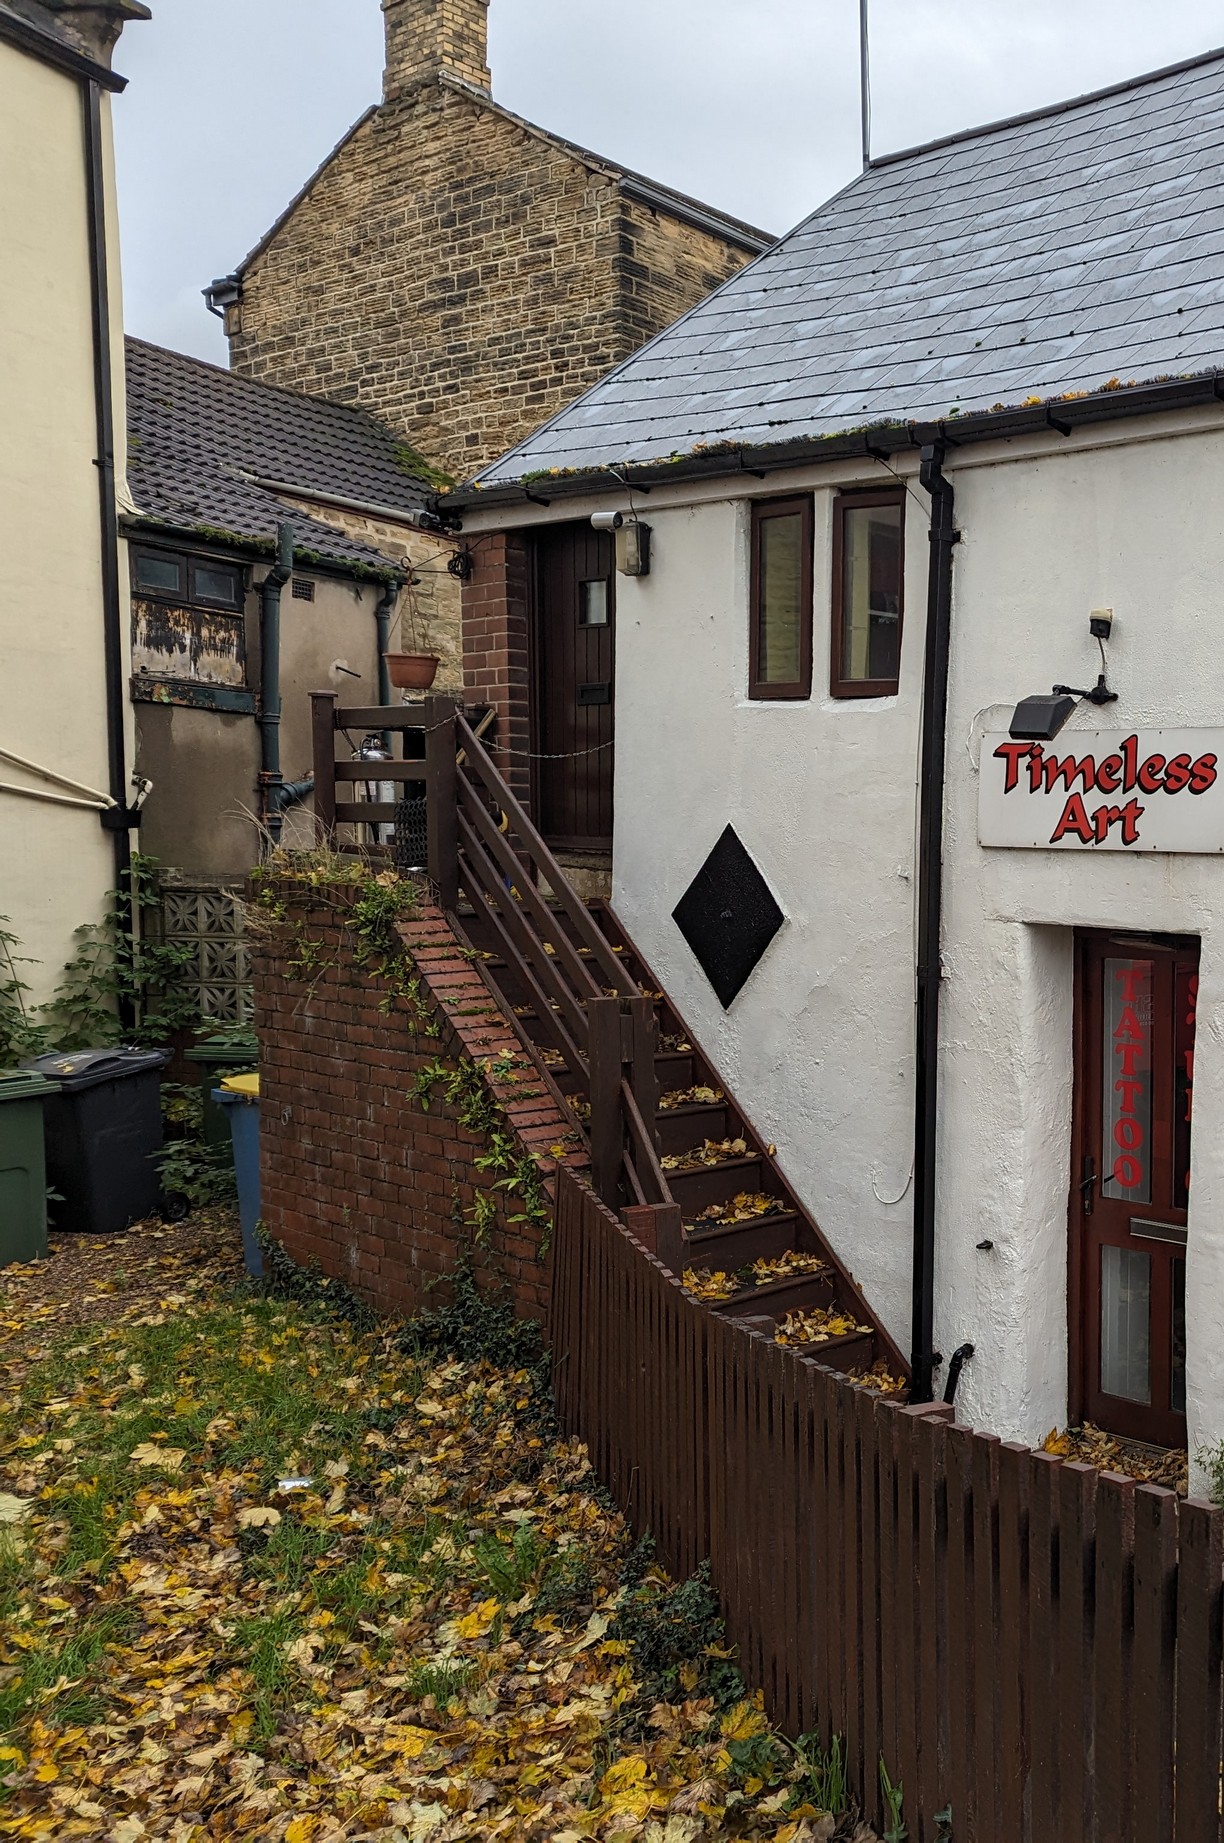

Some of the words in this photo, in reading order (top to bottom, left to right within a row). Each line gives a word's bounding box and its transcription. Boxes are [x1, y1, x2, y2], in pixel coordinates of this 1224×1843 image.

[993, 734, 1218, 795] Timeless
[1049, 792, 1145, 846] Art
[1113, 968, 1146, 1189] TATTOO
